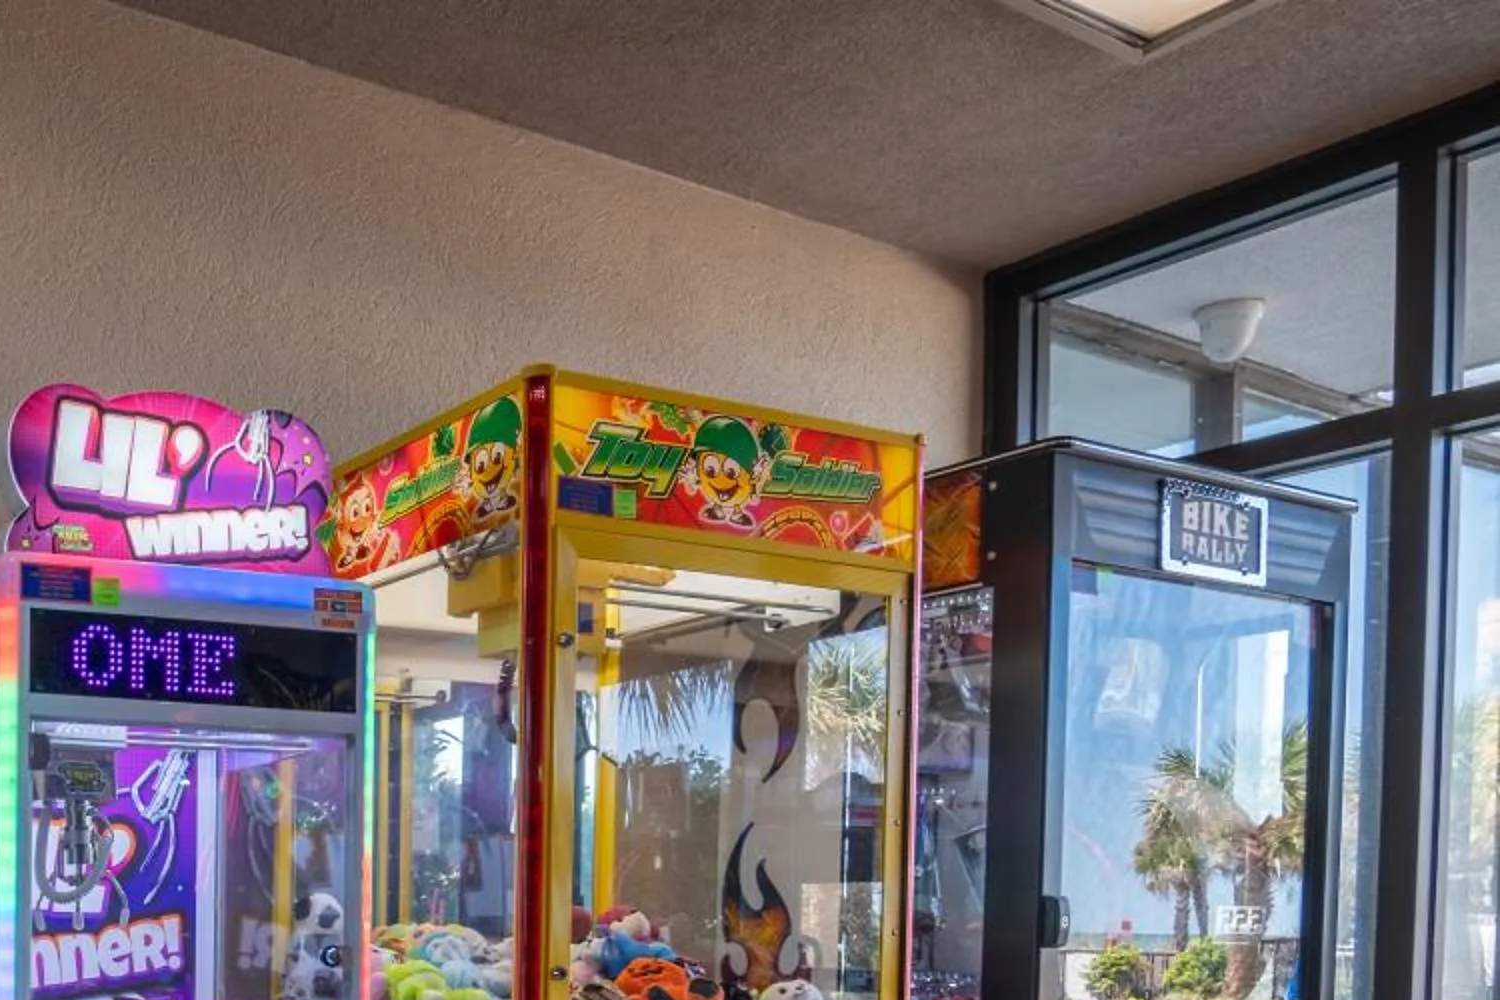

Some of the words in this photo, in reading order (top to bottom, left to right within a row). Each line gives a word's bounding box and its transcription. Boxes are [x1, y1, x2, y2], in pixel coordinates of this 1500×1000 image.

[53, 400, 204, 506] LIL'
[581, 421, 690, 497] Toy
[761, 451, 881, 502] Soldier
[1182, 501, 1250, 541] BIKE
[1182, 532, 1247, 564] RALLY
[72, 623, 236, 696] OME
